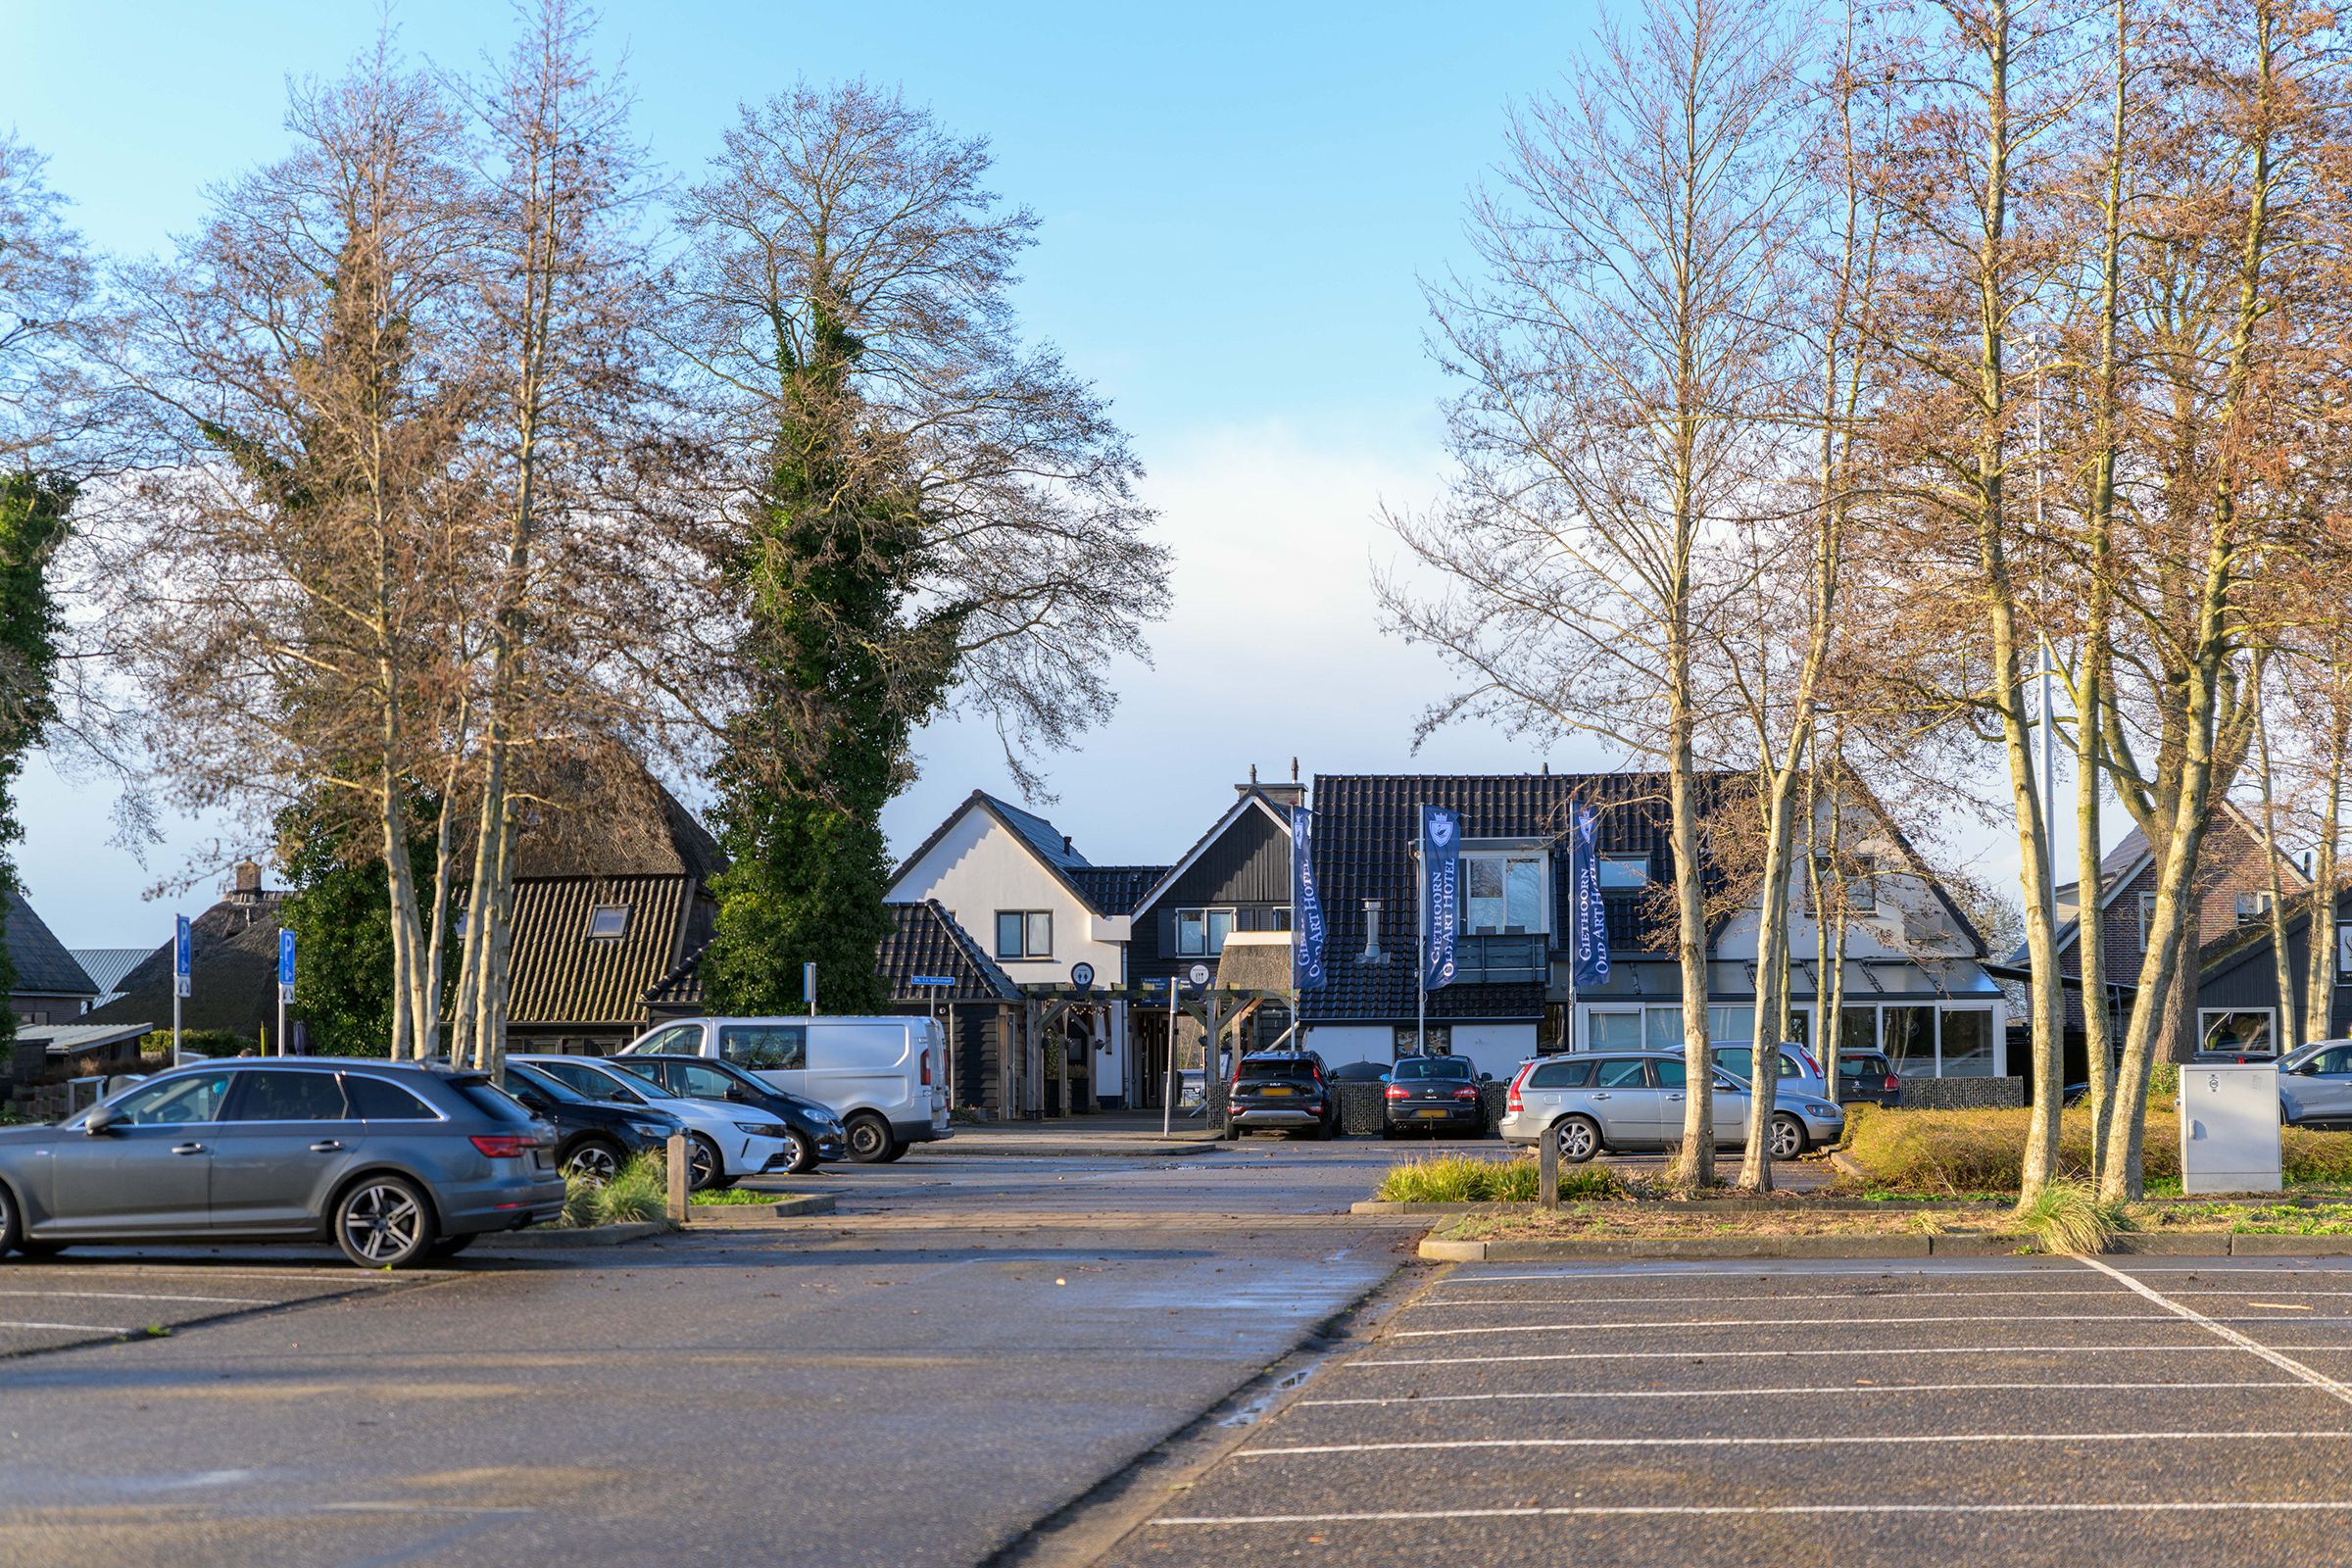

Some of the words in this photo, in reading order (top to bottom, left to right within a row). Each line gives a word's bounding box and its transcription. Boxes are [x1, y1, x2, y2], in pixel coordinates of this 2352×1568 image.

[1302, 858, 1318, 910] HOTEL
[1444, 858, 1455, 908] HOTEL
[1309, 912, 1323, 943] ART
[1431, 871, 1443, 964] GIETHOORN
[1443, 913, 1453, 943] ART
[1579, 868, 1592, 961] GIETHOORN
[1592, 907, 1604, 940] ART
[180, 921, 188, 949] P
[284, 935, 293, 959] P
[1443, 945, 1454, 977] OLD
[1595, 942, 1609, 974] OLD
